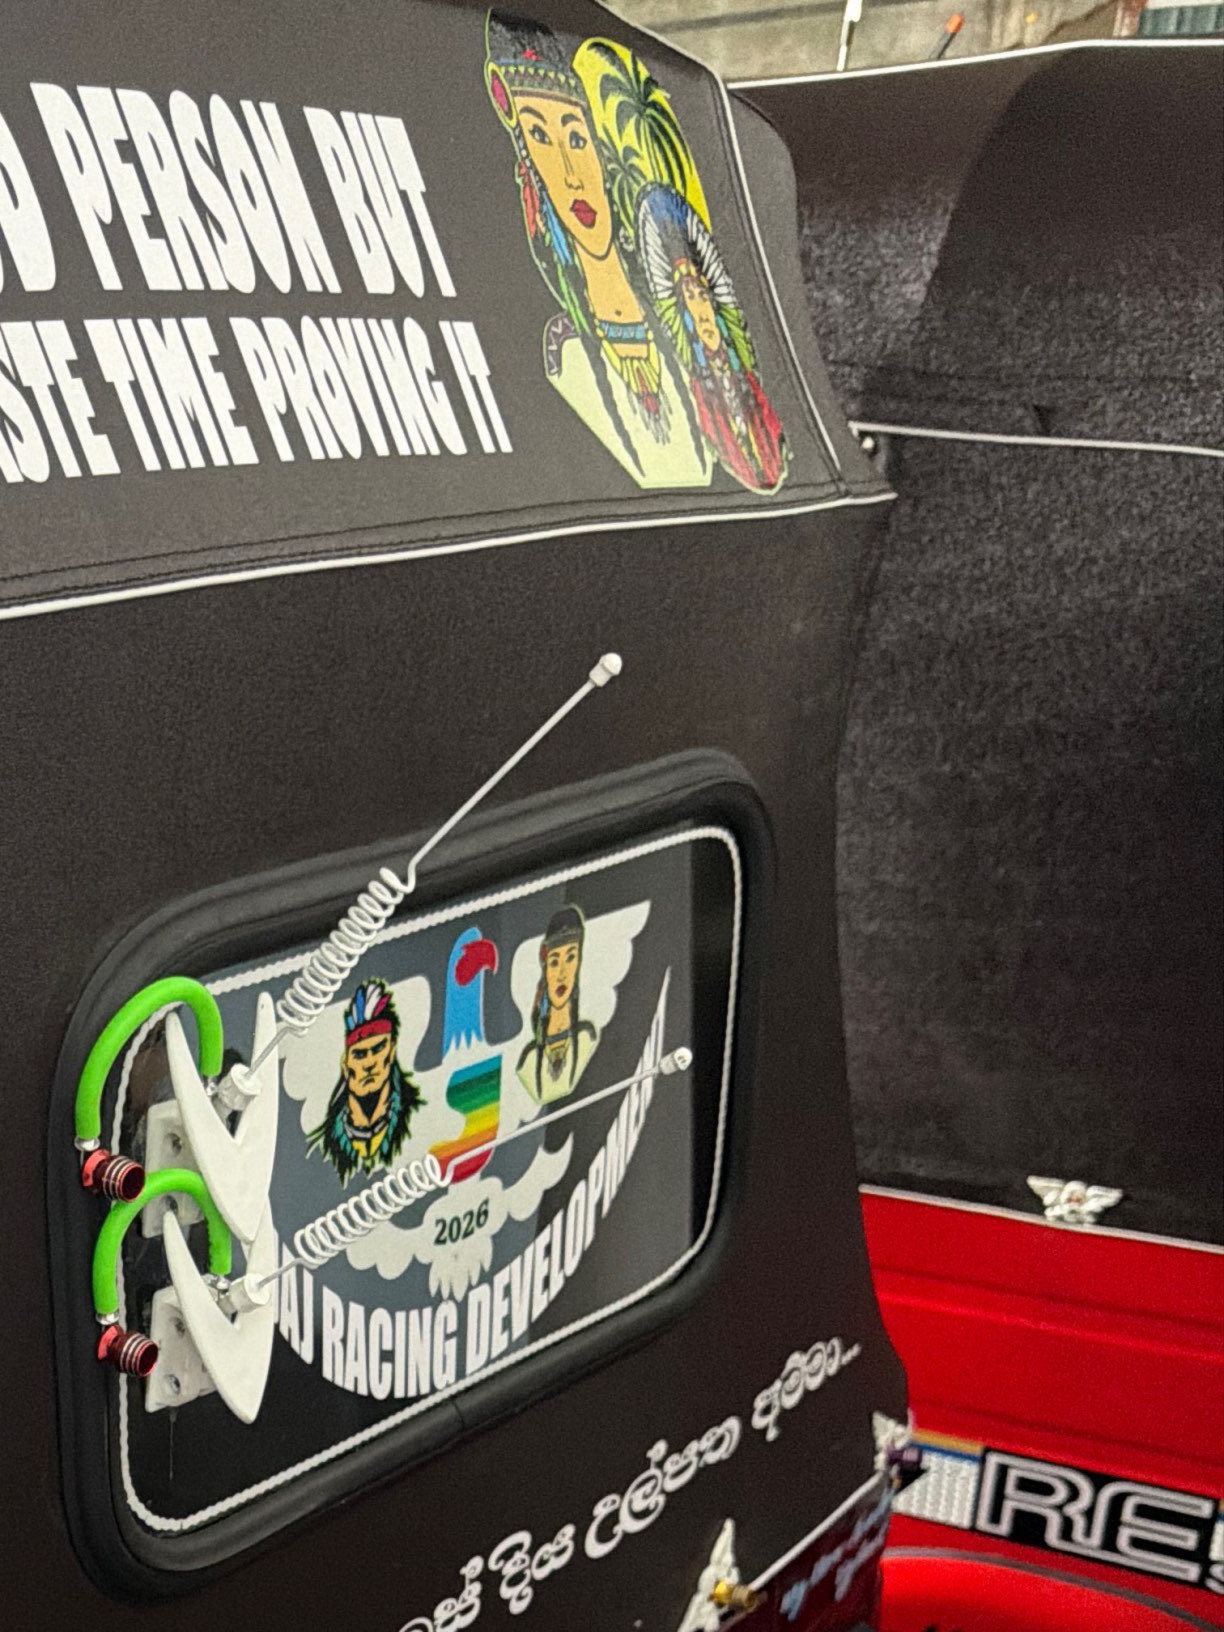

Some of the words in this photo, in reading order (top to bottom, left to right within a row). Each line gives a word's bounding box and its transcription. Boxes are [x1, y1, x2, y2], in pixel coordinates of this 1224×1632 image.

[30, 82, 342, 294] PERSON
[303, 105, 457, 298] BUT
[83, 317, 259, 472] TIME
[228, 316, 468, 463] PROVING
[442, 321, 514, 454] IT
[434, 1198, 489, 1247] 2026
[322, 1284, 459, 1401] RACING
